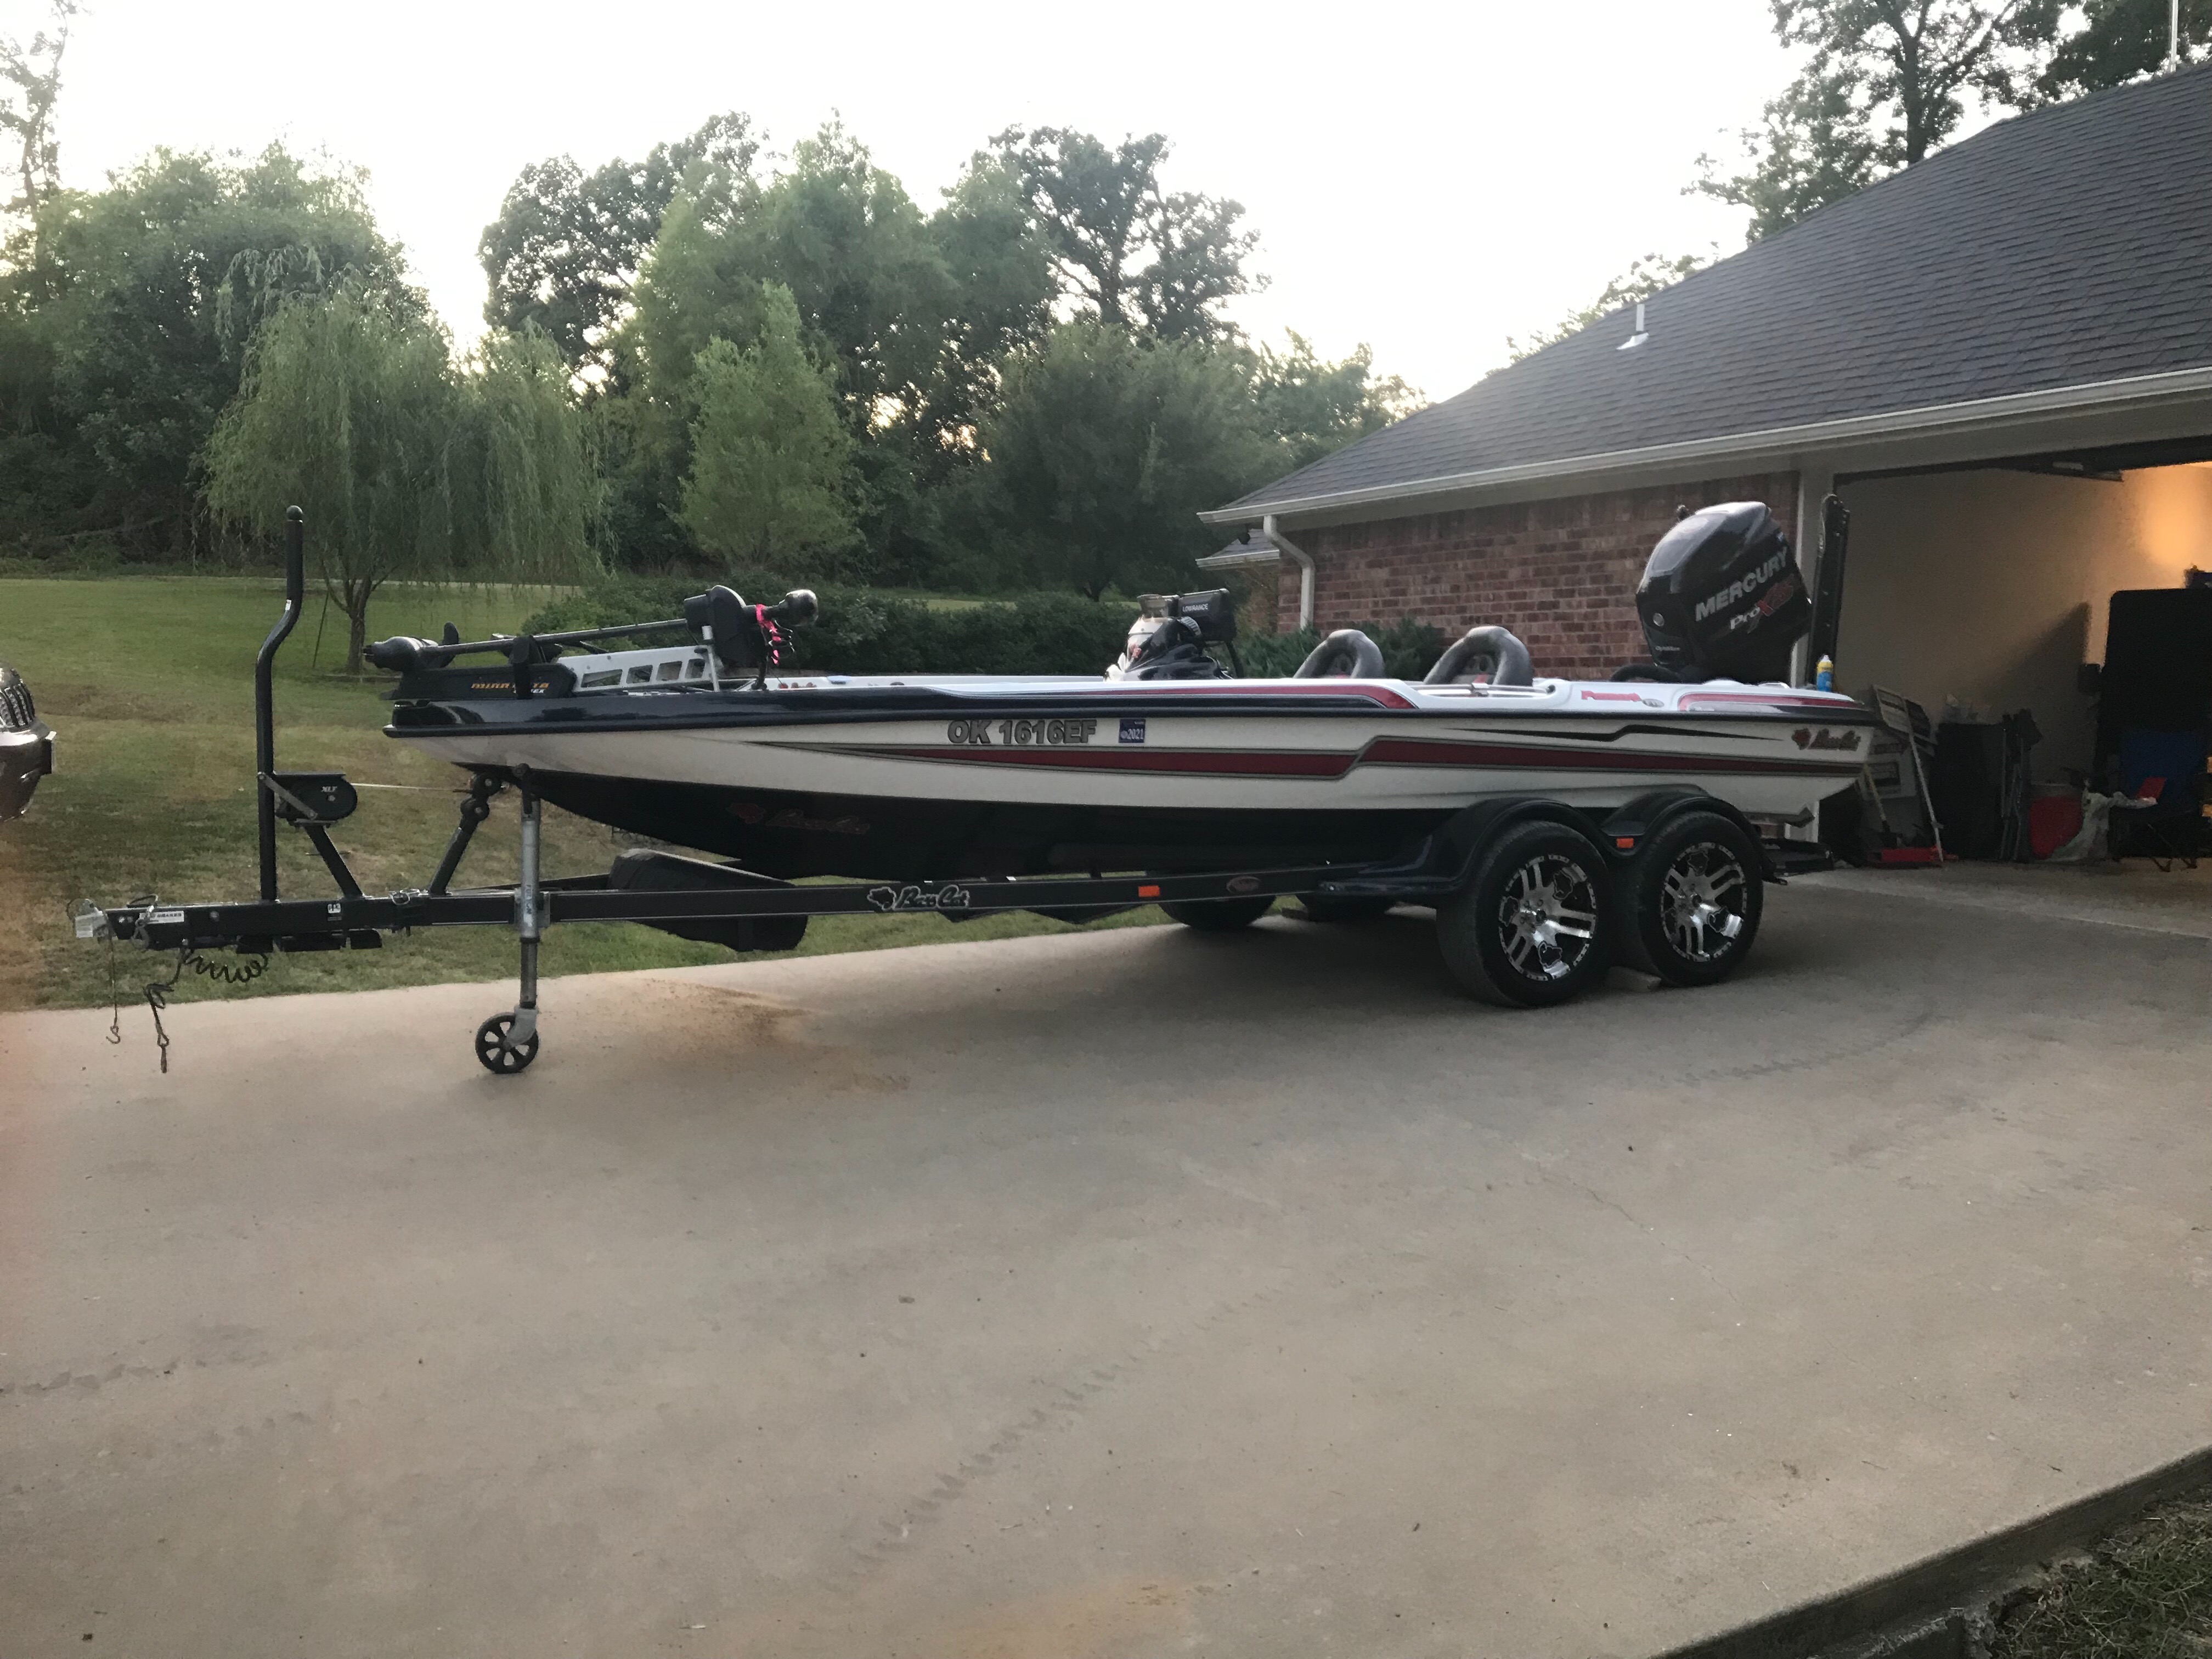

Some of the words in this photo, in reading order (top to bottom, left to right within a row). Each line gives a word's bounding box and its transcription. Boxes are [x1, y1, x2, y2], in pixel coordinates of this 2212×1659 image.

[1695, 546, 1787, 622] MERCURY
[1182, 603, 1209, 612] LOWRANCE
[947, 720, 992, 744] OK
[998, 719, 1097, 745] 1616EF
[1127, 729, 1144, 740] 2021
